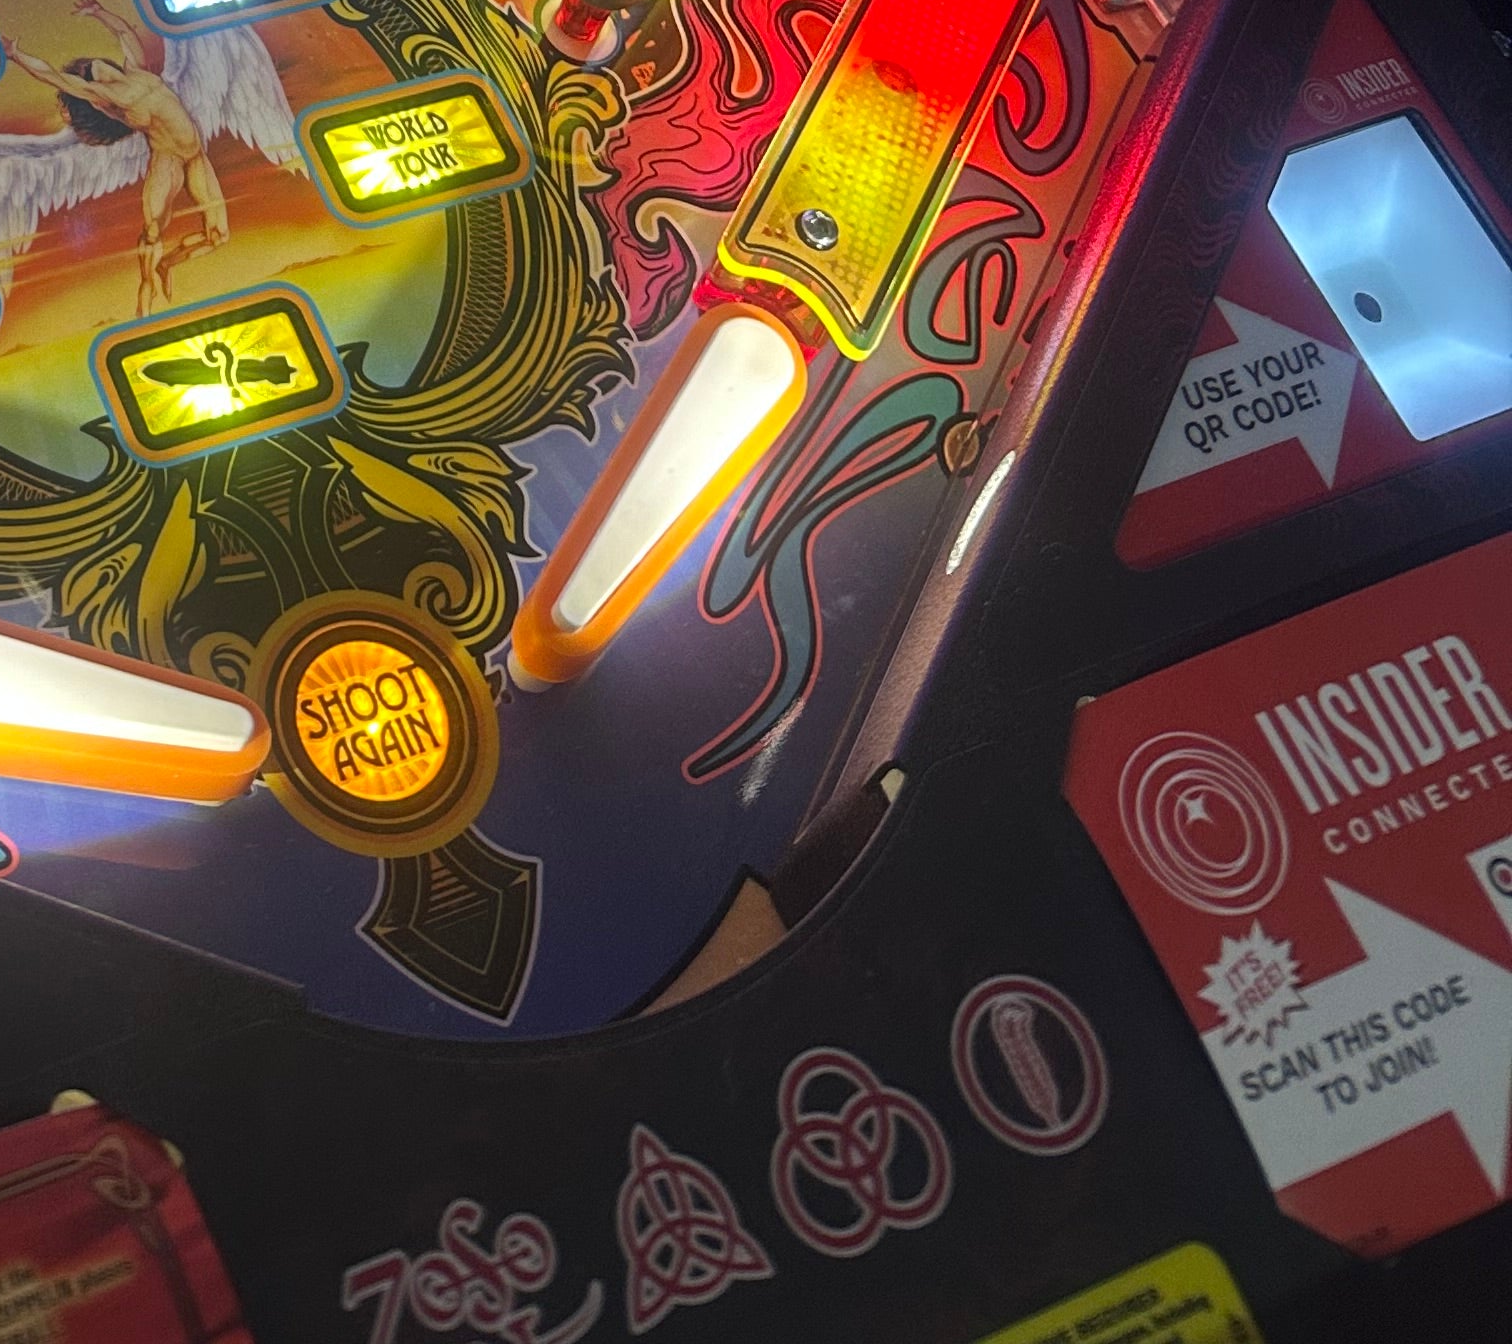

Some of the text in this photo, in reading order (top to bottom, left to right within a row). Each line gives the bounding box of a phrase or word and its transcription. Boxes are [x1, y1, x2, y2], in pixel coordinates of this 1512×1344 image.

[1335, 57, 1411, 102] INSIDER
[364, 110, 449, 147] WORLD
[388, 143, 460, 182] TOUR
[1180, 341, 1326, 411] USE YOUR
[1183, 379, 1323, 455] QR CODE!
[300, 662, 427, 741] SHOOT
[1254, 634, 1512, 814] INSIDER
[333, 708, 442, 782] AGAIN
[1321, 752, 1512, 855] CONNECTE
[1225, 949, 1263, 993] IT'S
[1235, 960, 1287, 1019] FREE!
[1239, 974, 1472, 1102] SCAN THIS CODE
[1315, 1035, 1440, 1114] TO JOIN!
